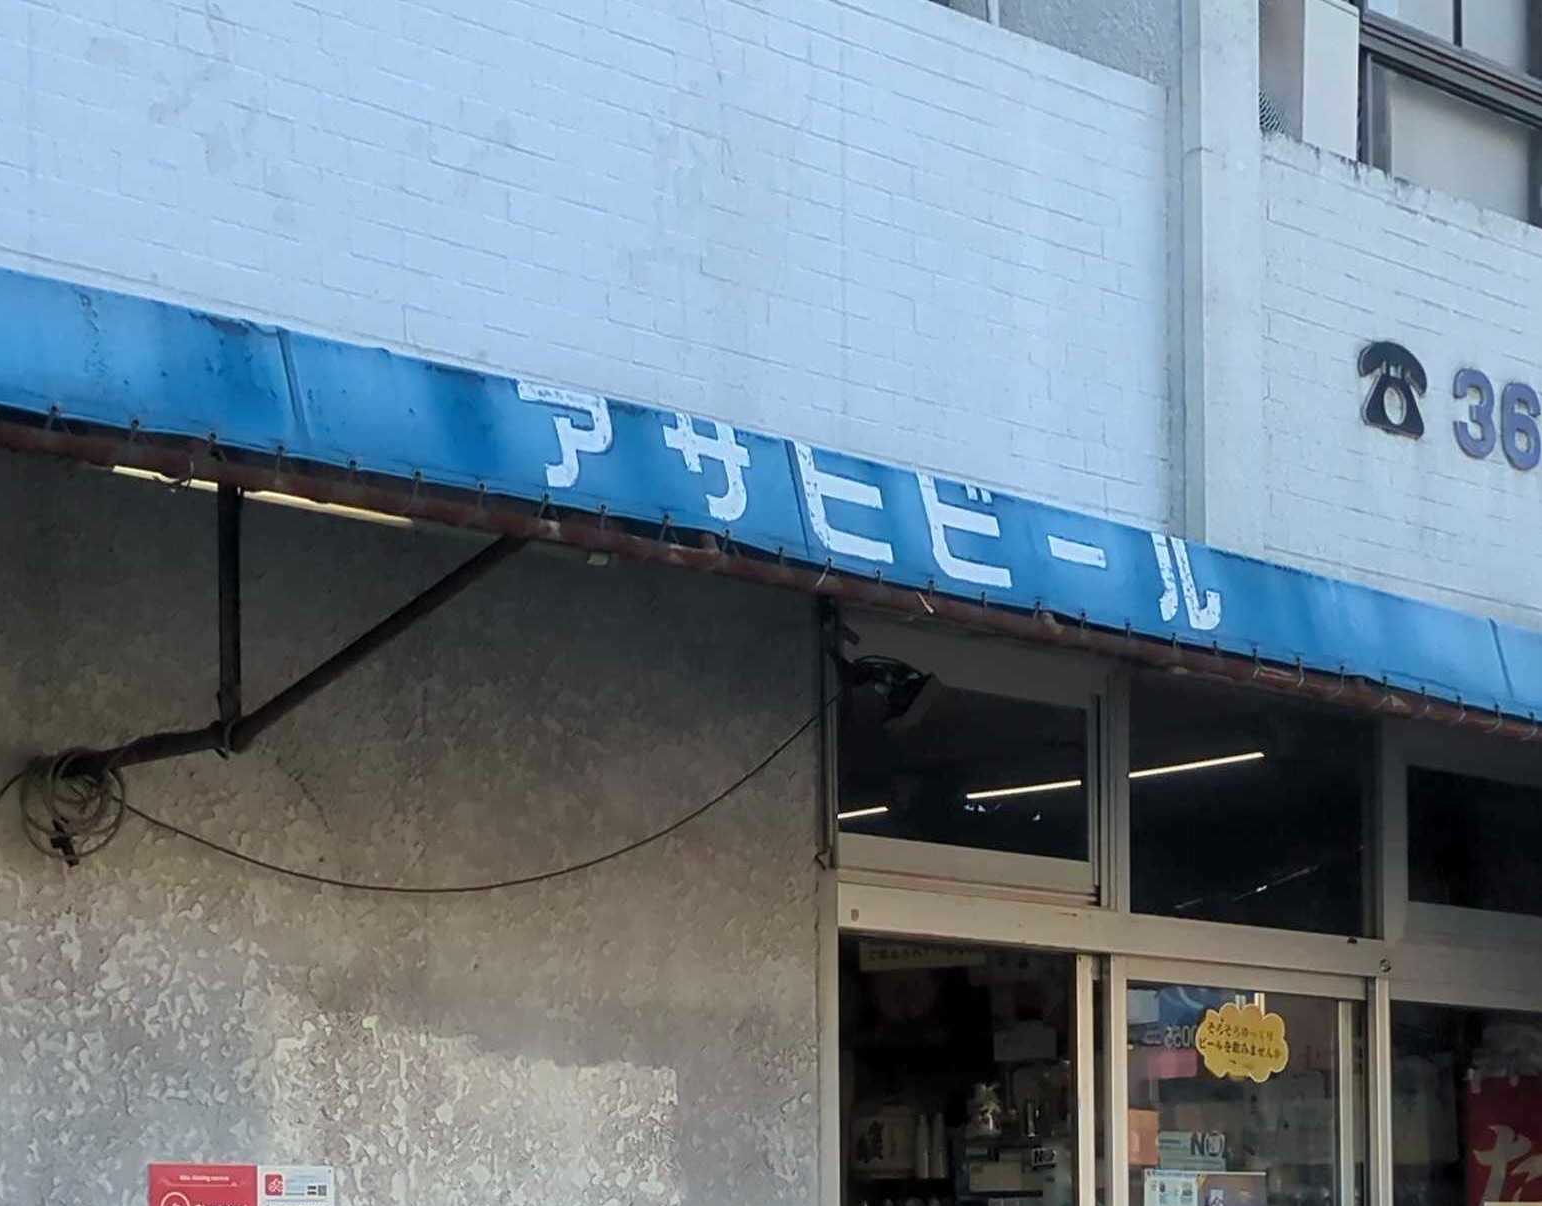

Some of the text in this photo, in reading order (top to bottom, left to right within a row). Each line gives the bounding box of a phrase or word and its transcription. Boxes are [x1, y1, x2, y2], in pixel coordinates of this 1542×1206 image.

[515, 378, 1223, 632] アサヒビール
